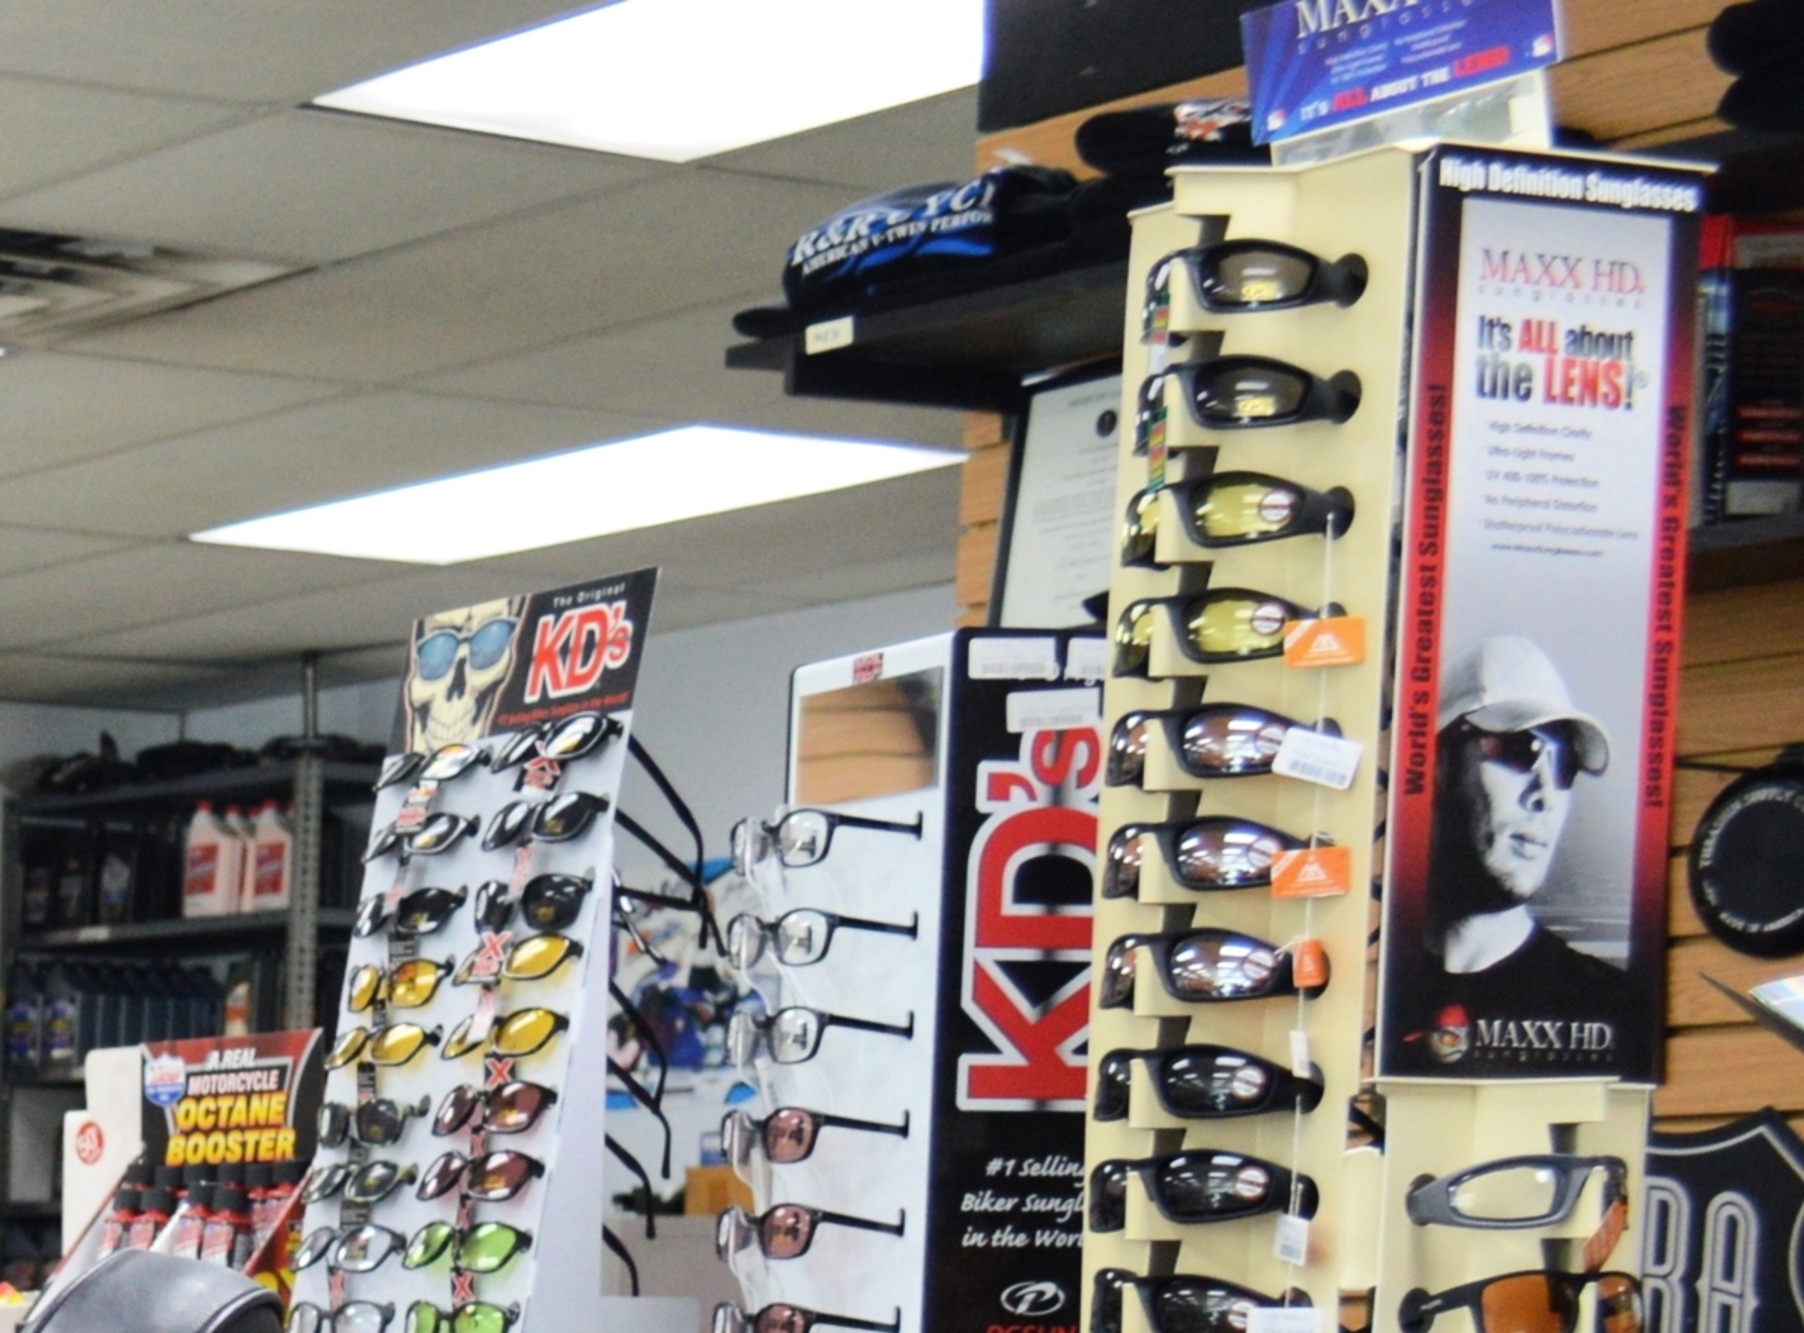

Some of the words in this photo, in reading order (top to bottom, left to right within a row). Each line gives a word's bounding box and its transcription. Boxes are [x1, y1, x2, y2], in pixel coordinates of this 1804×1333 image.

[1439, 157, 1490, 191] High
[1488, 162, 1585, 201] Definition
[1585, 174, 1701, 212] Sunglasses
[1479, 249, 1583, 290] MAXX
[1477, 314, 1512, 350] It's
[1518, 318, 1558, 354] ALL
[1563, 323, 1635, 358] about
[1474, 352, 1534, 402] the
[1541, 355, 1635, 411] LENS!
[1419, 383, 1448, 556] Sunglasses!
[1653, 516, 1681, 633] Greatest
[1410, 564, 1439, 683] Greatest
[523, 600, 633, 704] KD's
[1404, 688, 1431, 796] World's
[958, 726, 1101, 1110] KD's
[1475, 1019, 1564, 1049] MAXX
[1569, 1021, 1613, 1050] HD
[223, 1047, 256, 1068] REAL
[187, 1070, 280, 1096] MOTORCYCLE
[175, 1091, 288, 1131] OCTANE
[164, 1128, 296, 1167] BOOSTER
[984, 1157, 1015, 1177] #1
[960, 1190, 1020, 1212] Biker
[1021, 1193, 1085, 1223] Sungl
[961, 1226, 989, 1248] in
[991, 1225, 1030, 1247] the
[1034, 1229, 1084, 1248] Worl
